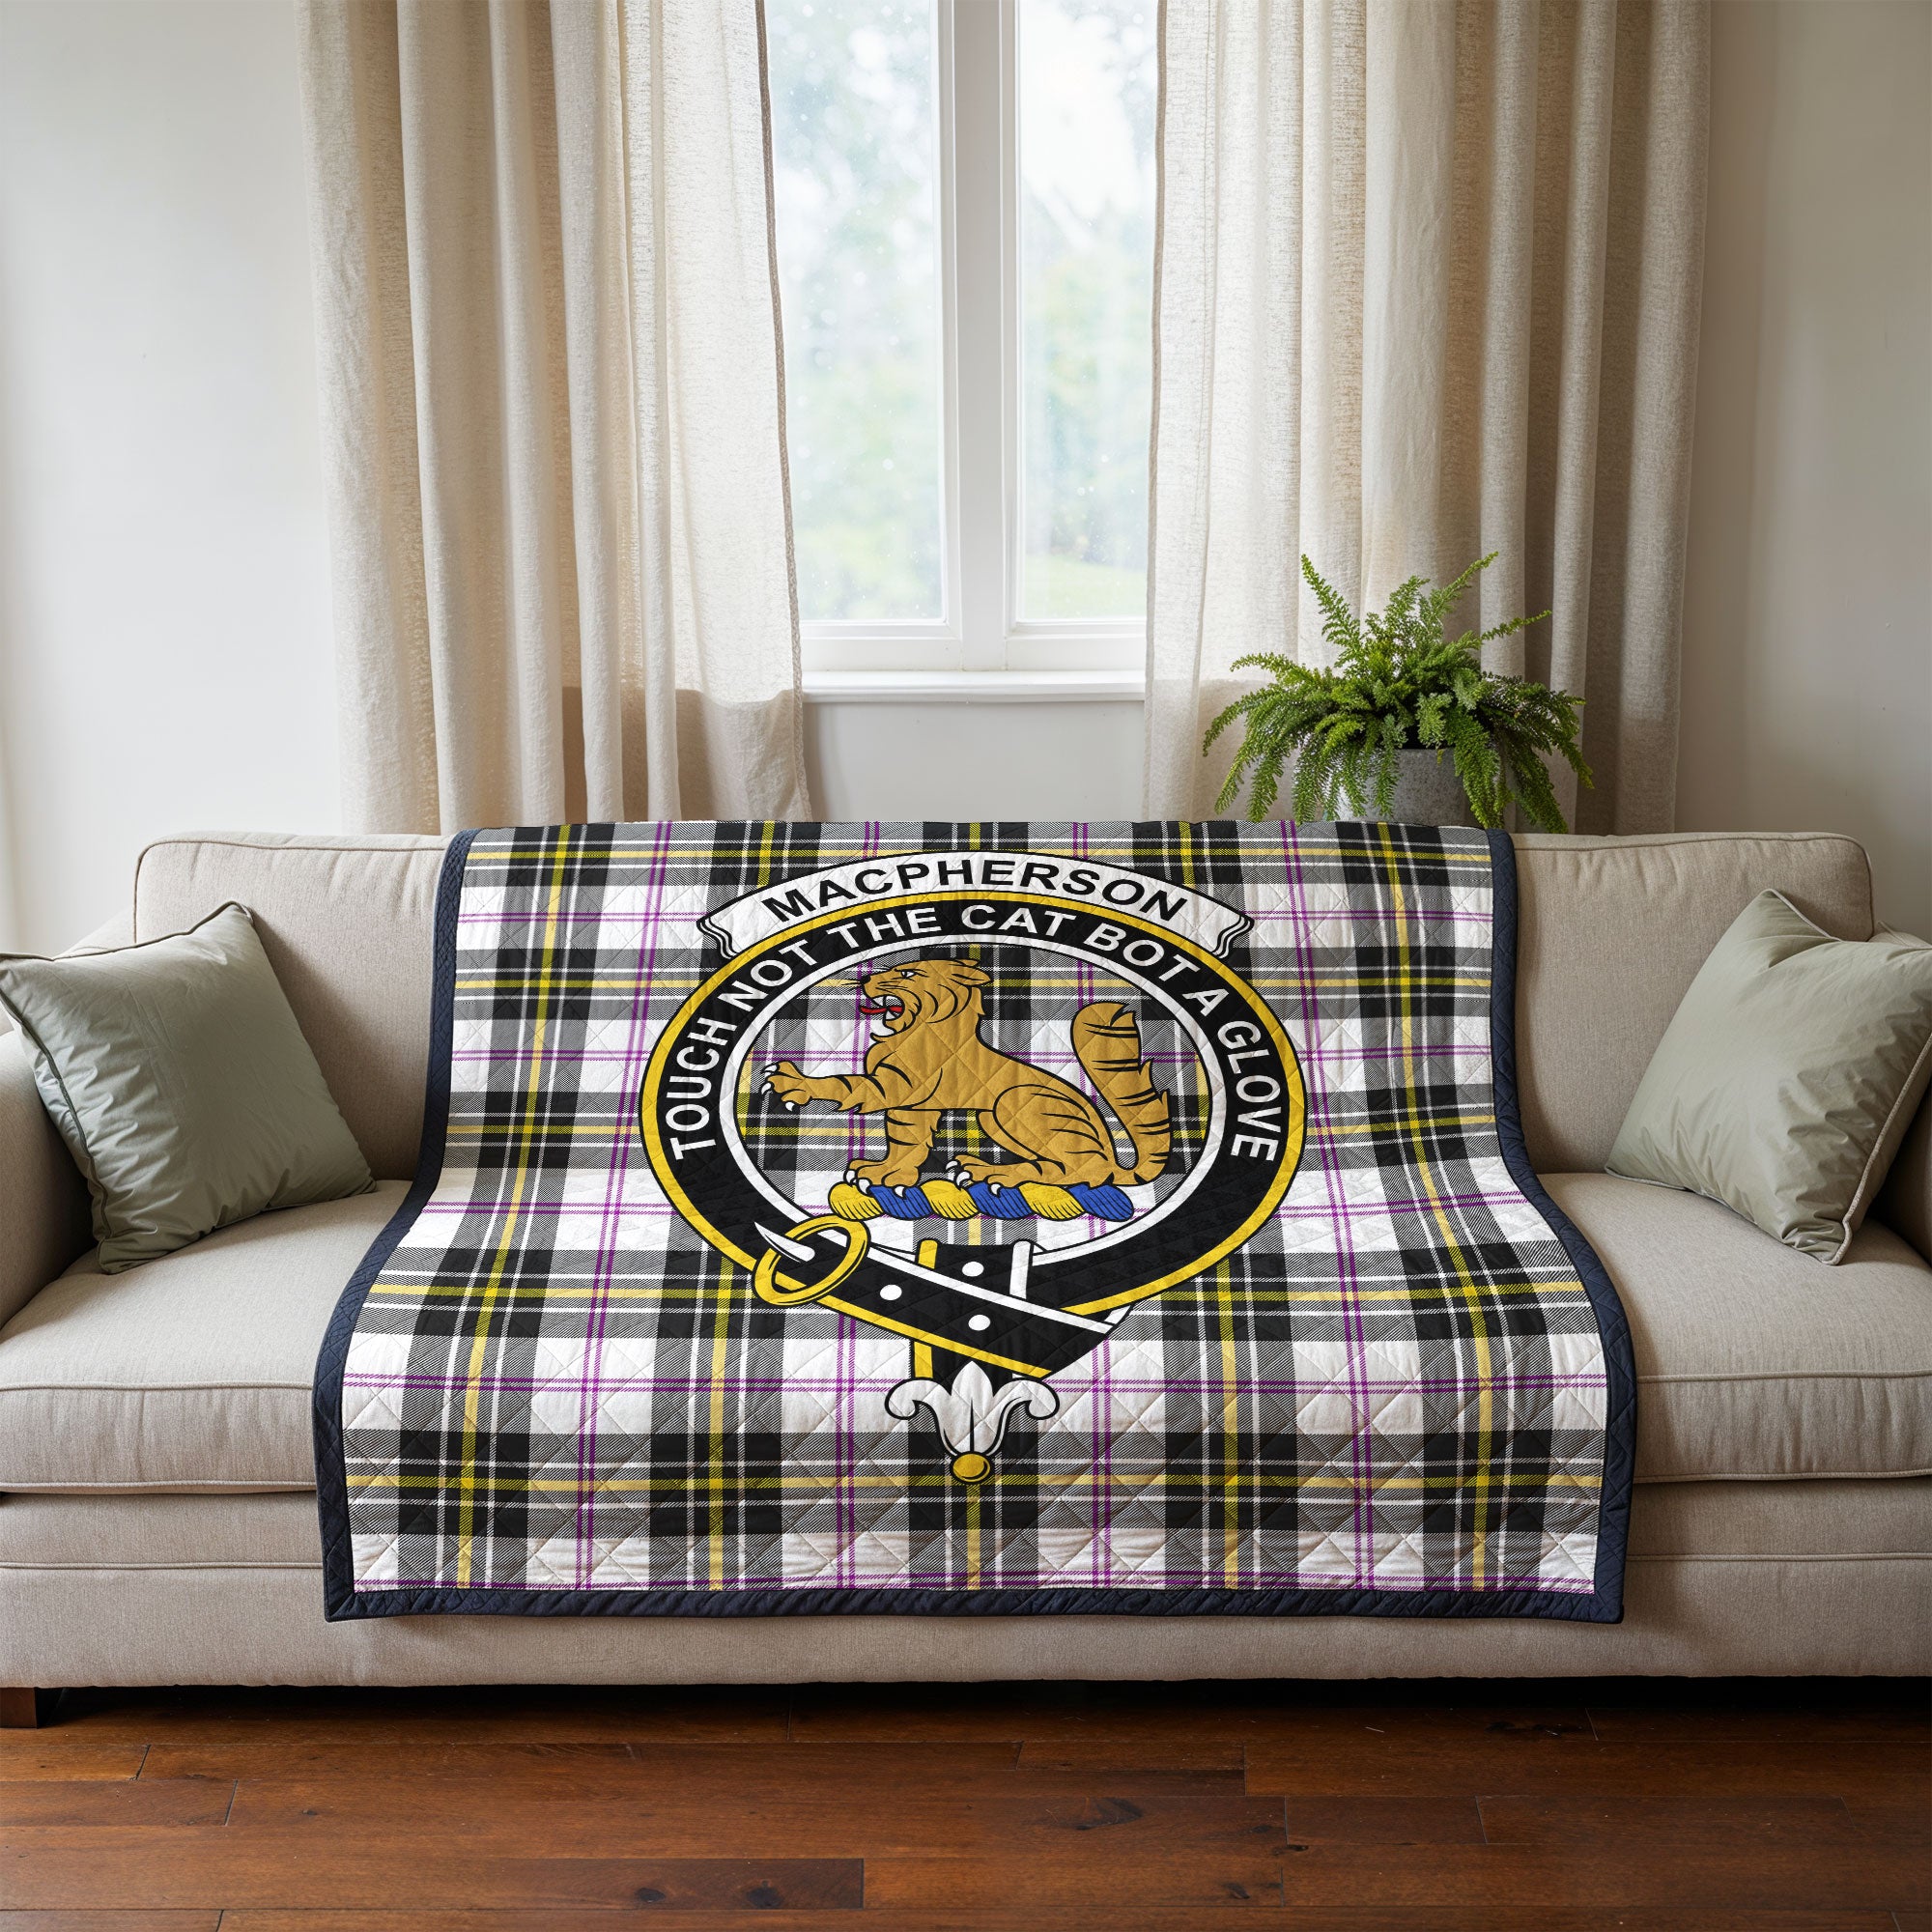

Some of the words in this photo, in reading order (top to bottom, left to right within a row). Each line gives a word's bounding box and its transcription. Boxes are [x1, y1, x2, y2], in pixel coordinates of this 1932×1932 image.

[760, 859, 1188, 923] MACPHERSON
[666, 1016, 738, 1160] TOUCH
[718, 938, 818, 1012] NOT
[826, 908, 942, 949] THE
[962, 905, 1077, 937] CAT
[1084, 923, 1201, 982] BOT
[1182, 989, 1229, 1017] A
[1218, 1021, 1282, 1162] GLOVE
